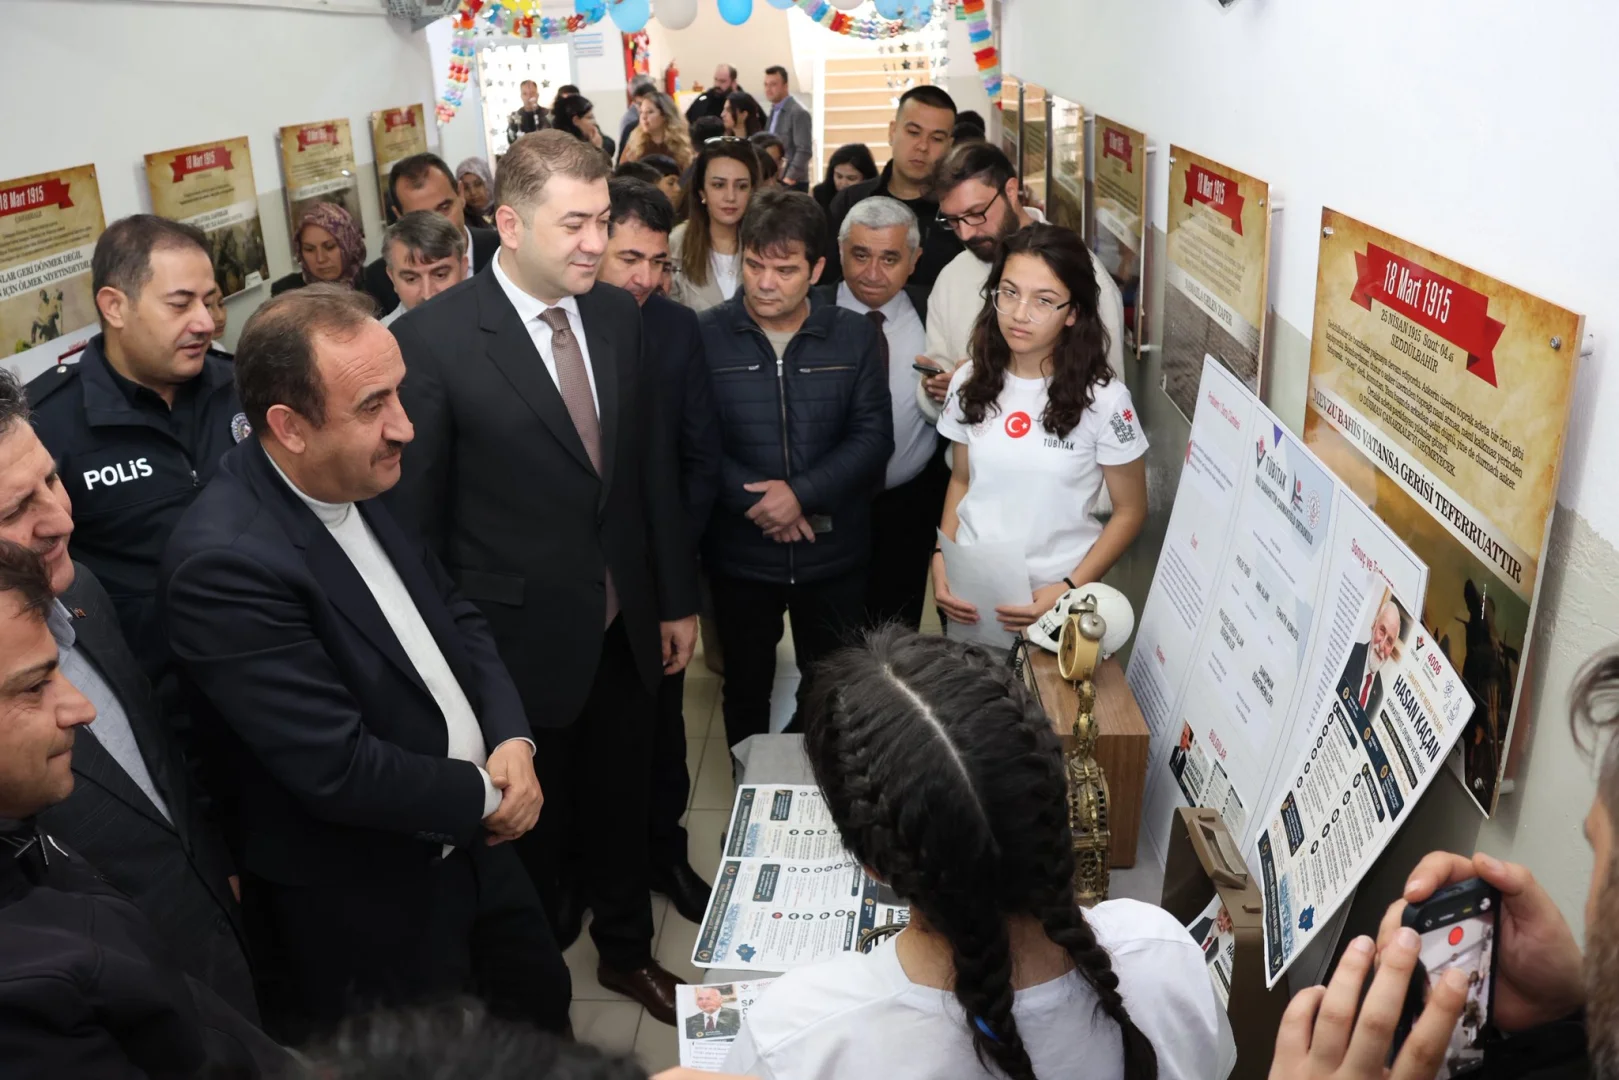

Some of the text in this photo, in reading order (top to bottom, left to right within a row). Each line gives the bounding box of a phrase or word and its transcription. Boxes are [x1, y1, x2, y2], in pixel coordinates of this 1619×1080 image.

[9, 188, 25, 208] Mart
[26, 184, 44, 204] 1915
[1384, 260, 1453, 323] 18 Mart 1915
[1380, 308, 1388, 323] 25
[1387, 310, 1408, 335] NİSAN
[1408, 323, 1421, 343] 1915
[1390, 330, 1438, 374] SEDDÜLBAHİR
[1044, 437, 1075, 450] TÜBİTAK
[1474, 417, 1490, 437] adeta
[1490, 428, 1499, 444] bir
[1512, 443, 1524, 463] gibi
[1265, 453, 1287, 491] TÜBİTAK
[1361, 427, 1400, 476] VATANSA
[1400, 457, 1434, 505] GERİSİ
[1434, 490, 1523, 585] TEFERRUATTIR
[1428, 653, 1442, 675] 4006
[1393, 673, 1420, 721] HASAN
[1414, 711, 1440, 762] KAÇAN
